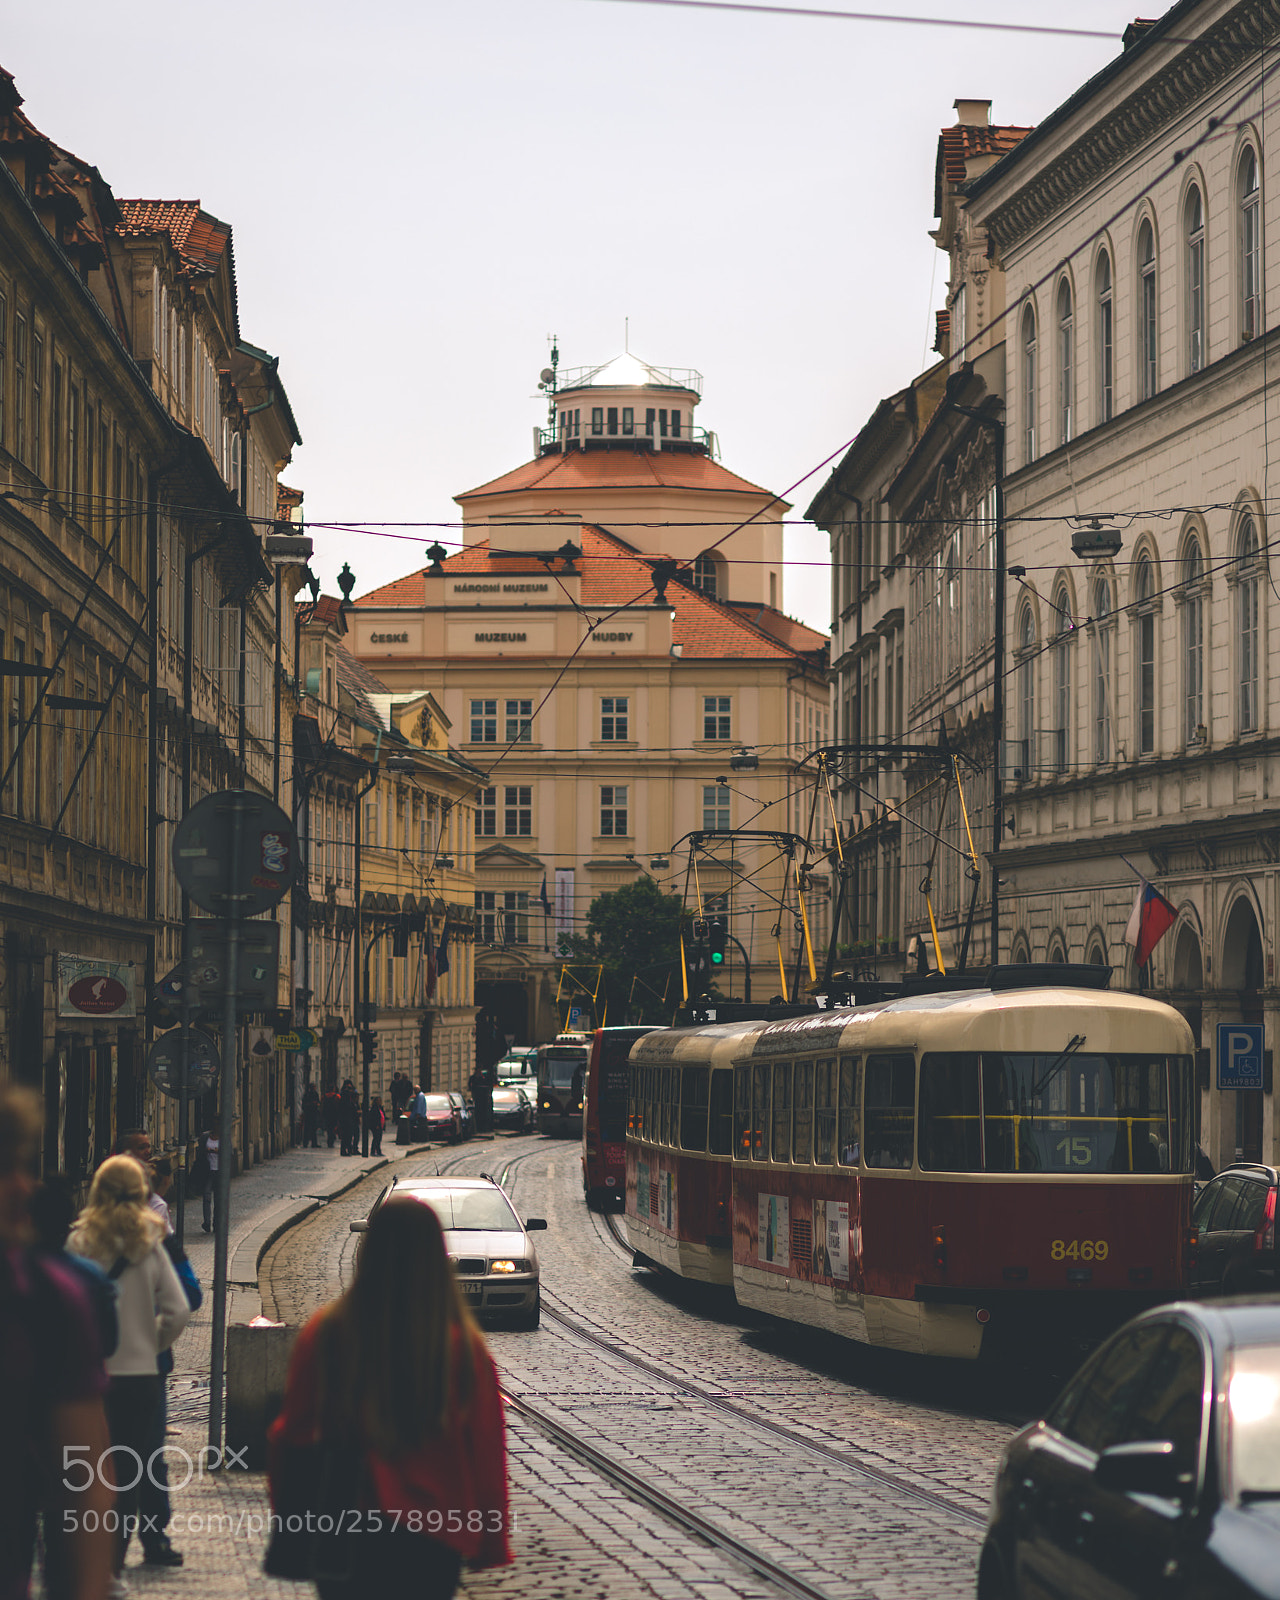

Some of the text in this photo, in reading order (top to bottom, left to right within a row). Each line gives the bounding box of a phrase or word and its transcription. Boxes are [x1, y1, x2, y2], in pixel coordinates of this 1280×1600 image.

[454, 583, 548, 593] NÁRODNÍ MUZEUM
[370, 632, 409, 644] ČESKÉ
[475, 633, 527, 642] MUZEUM
[592, 632, 633, 642] HUDBY
[1228, 1032, 1254, 1069] P
[1056, 1137, 1092, 1165] 15
[1050, 1240, 1109, 1261] 8469
